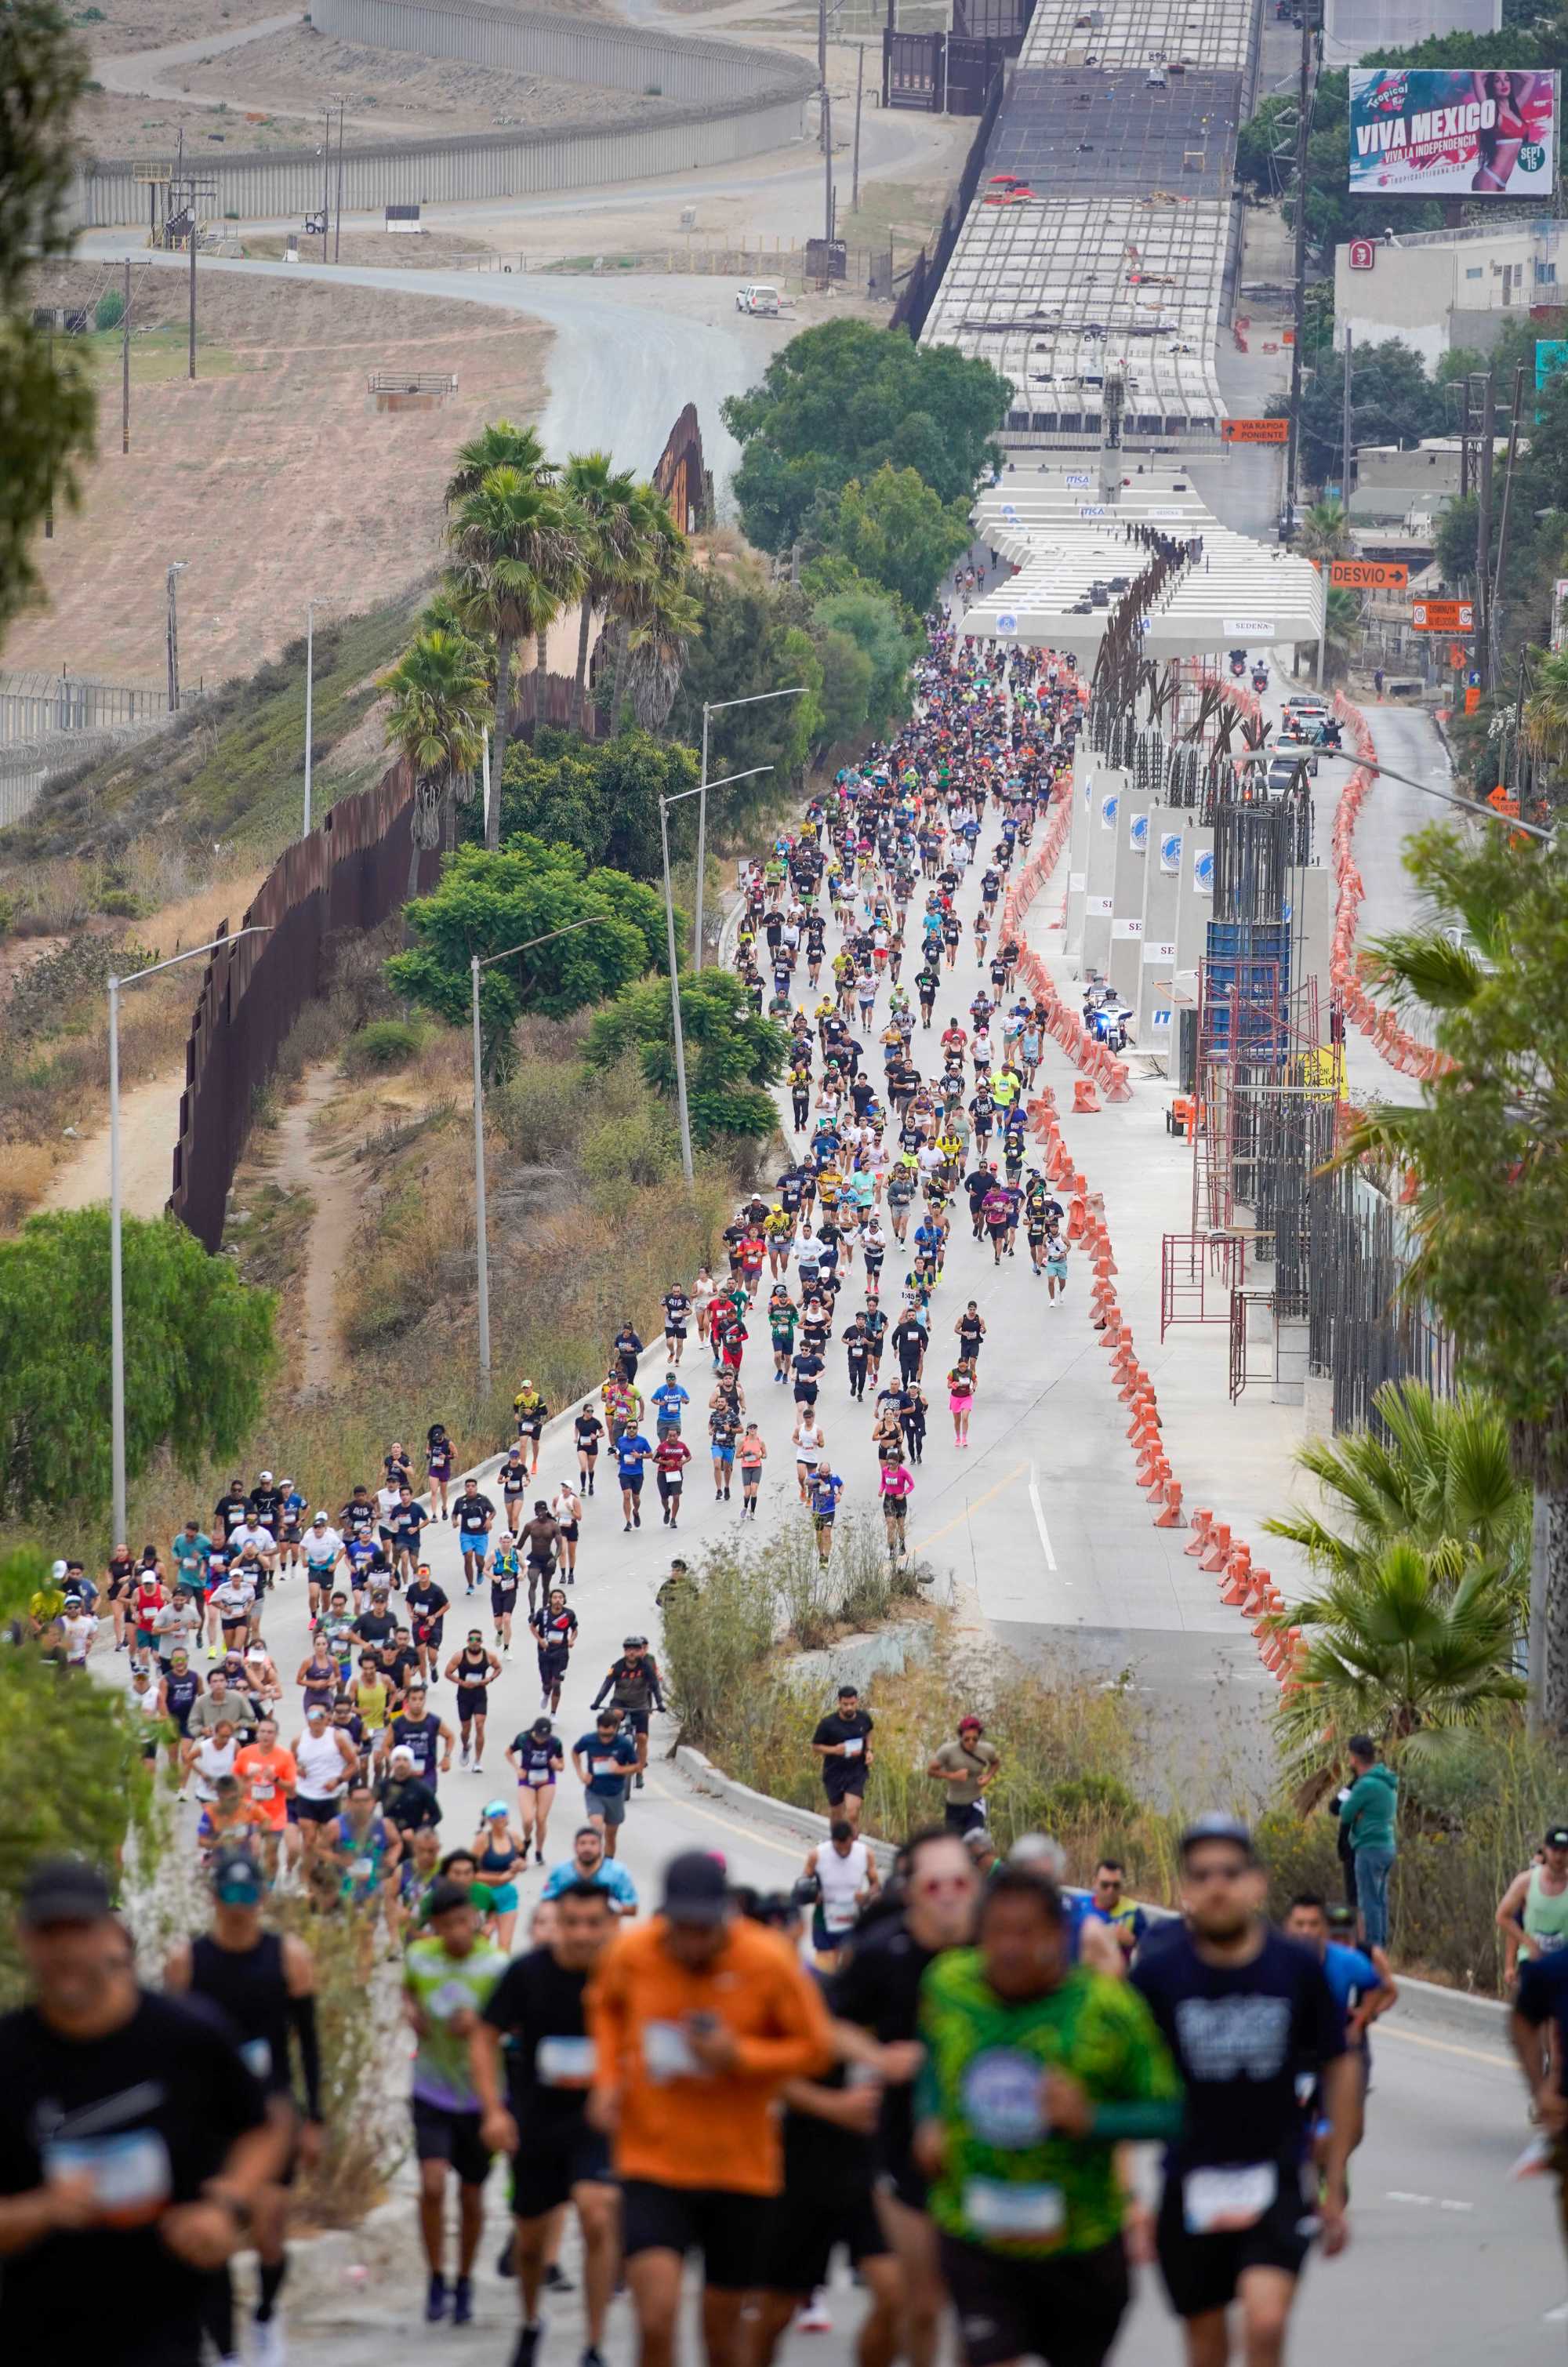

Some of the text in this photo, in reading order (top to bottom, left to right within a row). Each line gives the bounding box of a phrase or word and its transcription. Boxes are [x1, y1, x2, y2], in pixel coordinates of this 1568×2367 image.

[1367, 82, 1408, 108] Tropical
[1392, 96, 1405, 107] Bar
[1356, 99, 1496, 155] VIVA MEXICO
[1385, 134, 1476, 164] VIVA LA INDEPENDENCIA
[1521, 146, 1541, 160] SEPT
[1528, 158, 1537, 169] 15
[1334, 566, 1385, 583] DESVIO
[902, 1291, 915, 1300] 1:45
